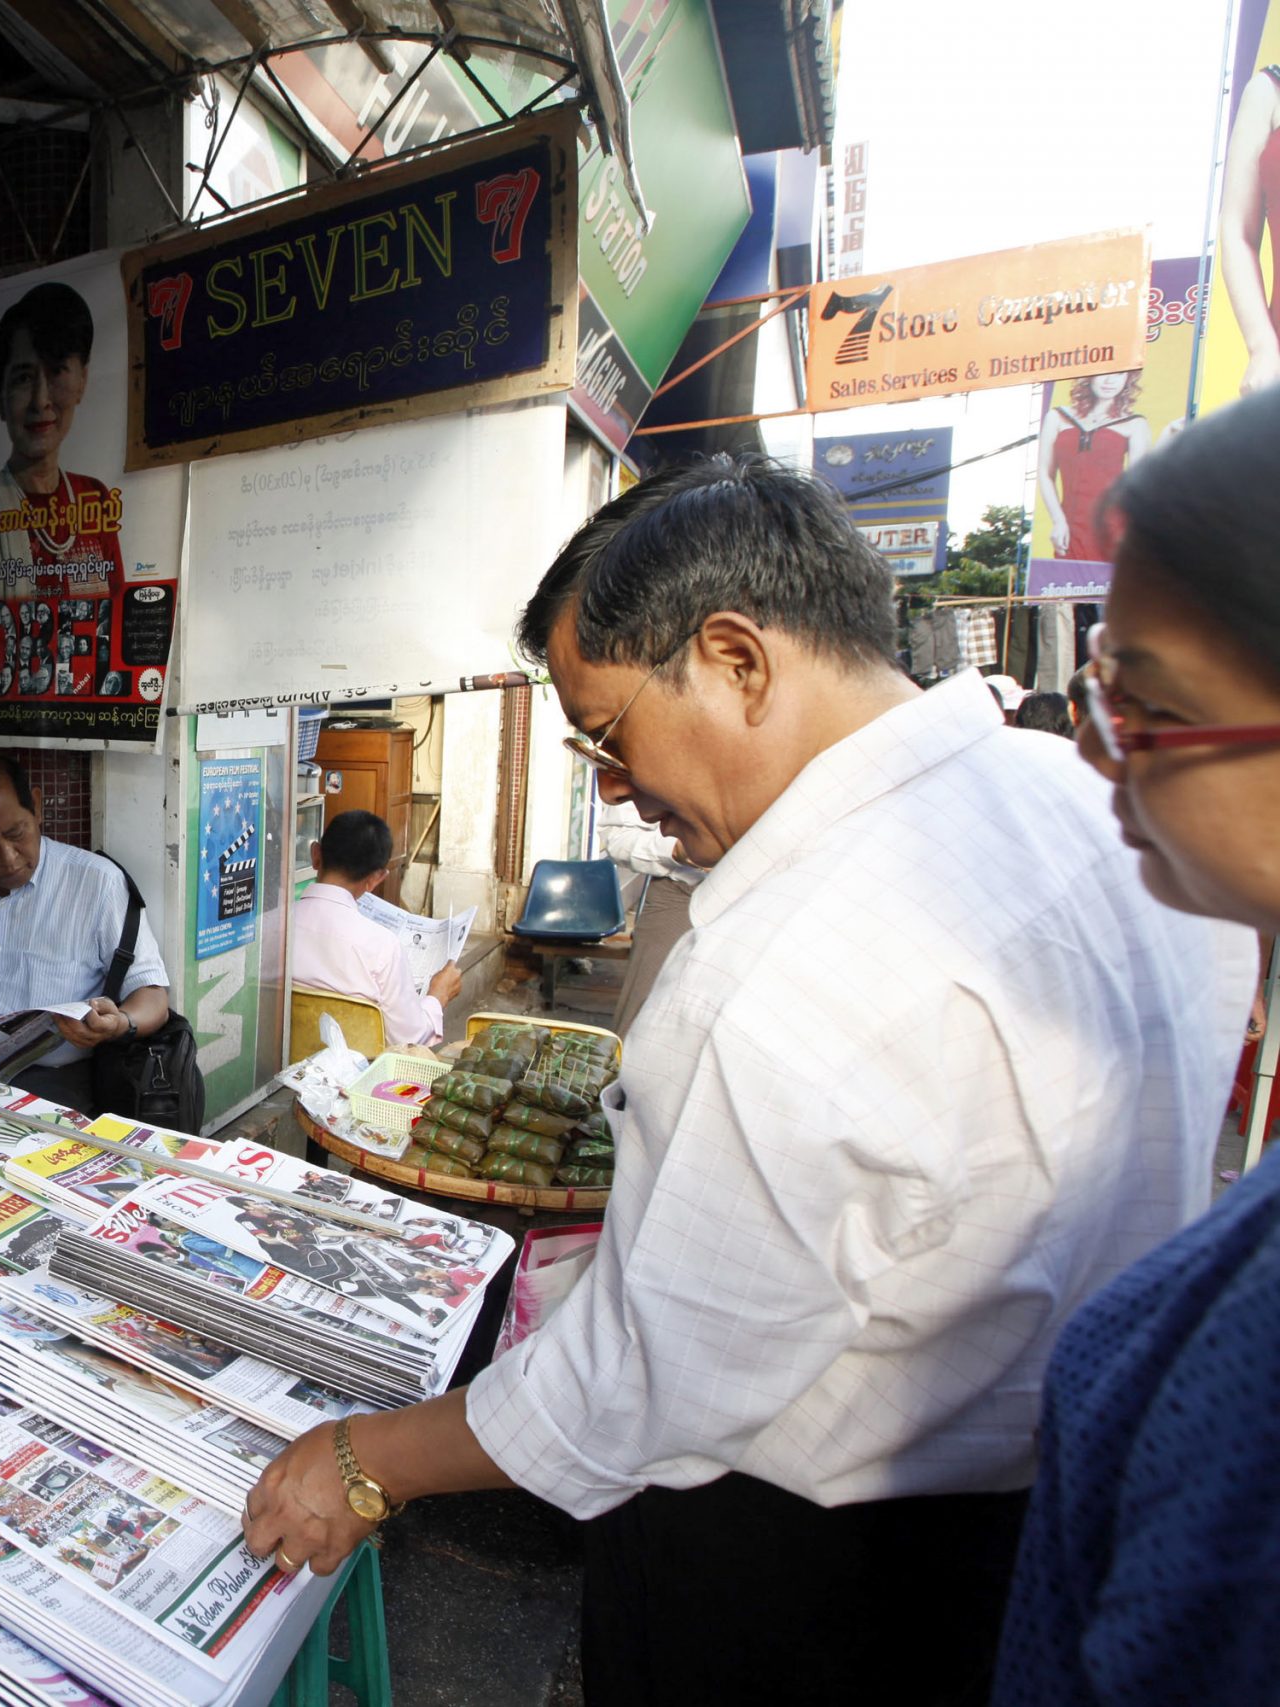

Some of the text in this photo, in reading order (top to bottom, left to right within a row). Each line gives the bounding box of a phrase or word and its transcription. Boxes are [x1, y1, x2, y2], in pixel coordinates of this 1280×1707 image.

[475, 167, 540, 265] 7
[205, 192, 457, 339] SEVEN
[147, 272, 193, 351] 7
[820, 283, 894, 365] 7
[878, 308, 958, 343] Store
[977, 279, 1135, 328] Computer
[880, 365, 957, 391] Services
[964, 362, 980, 380] &
[989, 344, 1114, 378] Distribution
[183, 1598, 225, 1628] Eden
[207, 1567, 253, 1602] Palace
